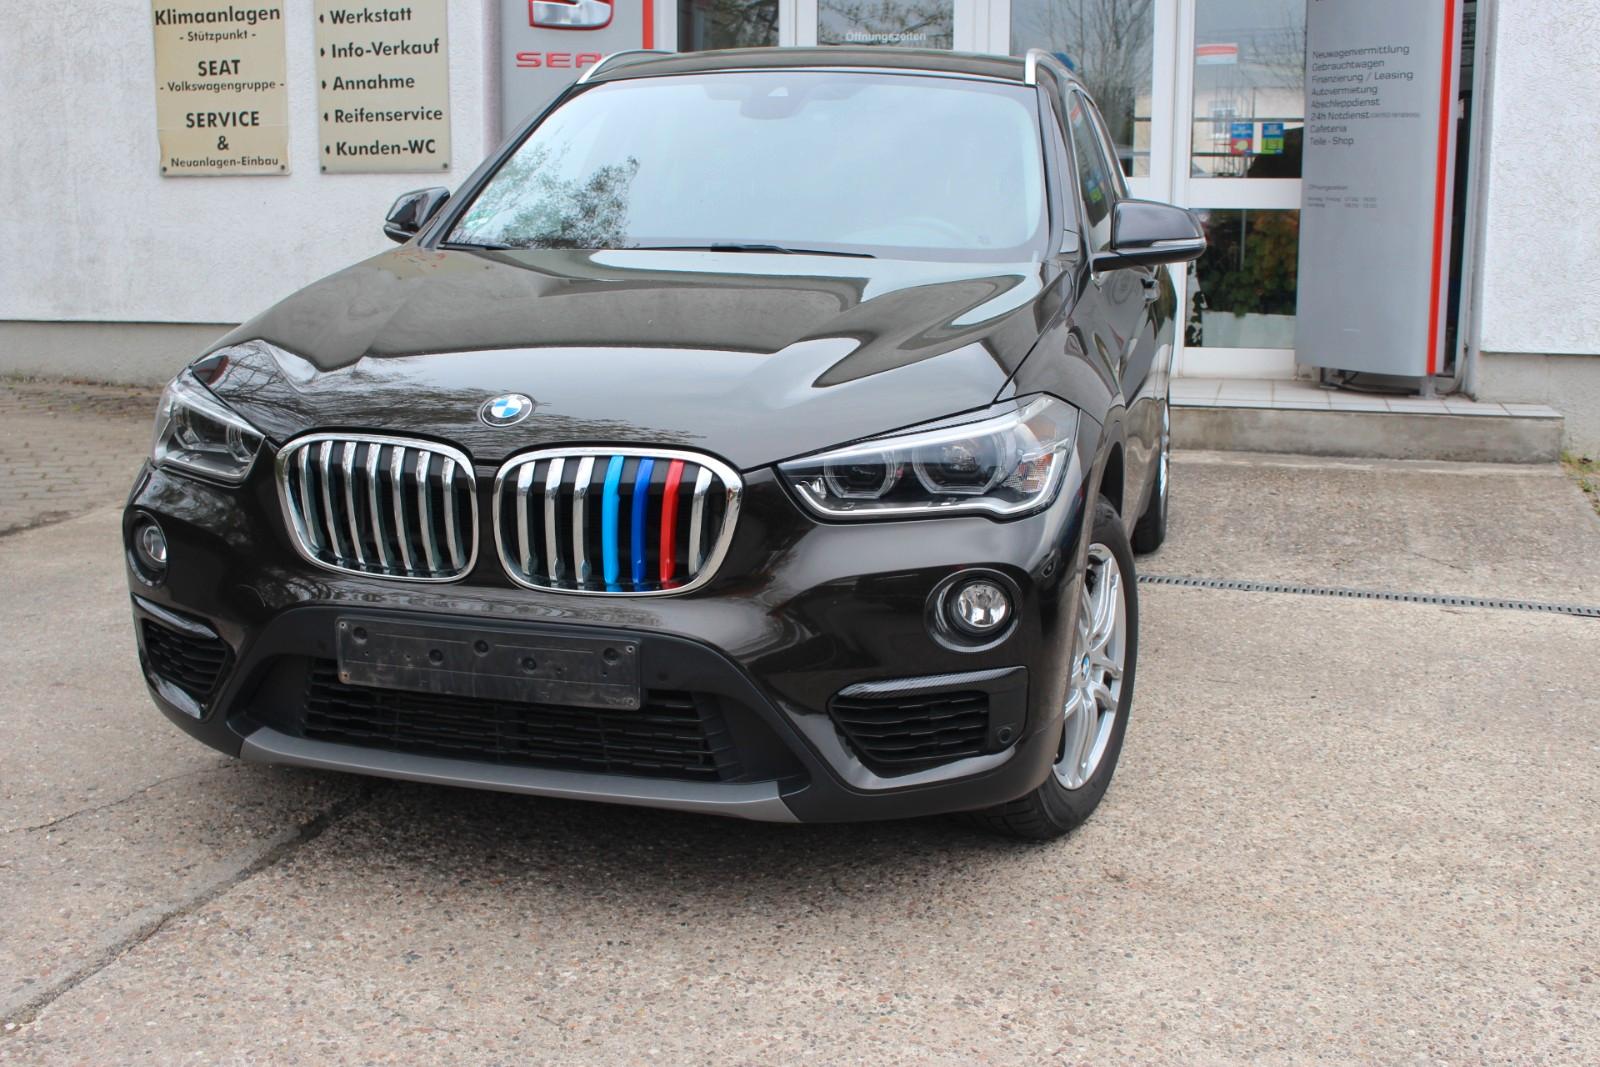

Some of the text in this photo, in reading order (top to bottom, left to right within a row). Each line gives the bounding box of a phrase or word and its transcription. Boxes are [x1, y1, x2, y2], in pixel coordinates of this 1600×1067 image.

[155, 5, 280, 25] Klimaanlagen
[330, 7, 412, 24] Werkstatt
[187, 29, 248, 42] Stützpunkt
[331, 38, 440, 58] Info-Verkauf
[198, 59, 240, 77] SEAT
[516, 52, 603, 68] SEA
[1312, 59, 1385, 72] Gebrauchtwagen
[332, 74, 415, 91] Annahme
[1374, 71, 1414, 82] Leasing
[168, 81, 276, 94] Volkswagengruppe
[186, 111, 260, 128] SERVICE
[335, 107, 443, 124] Reifenservice
[1328, 111, 1369, 121] Notdienst
[217, 135, 229, 151] &
[336, 139, 436, 157] Kunden-WC
[1332, 136, 1355, 147] Shop
[171, 156, 279, 169] Neuanlagen-Einbau
